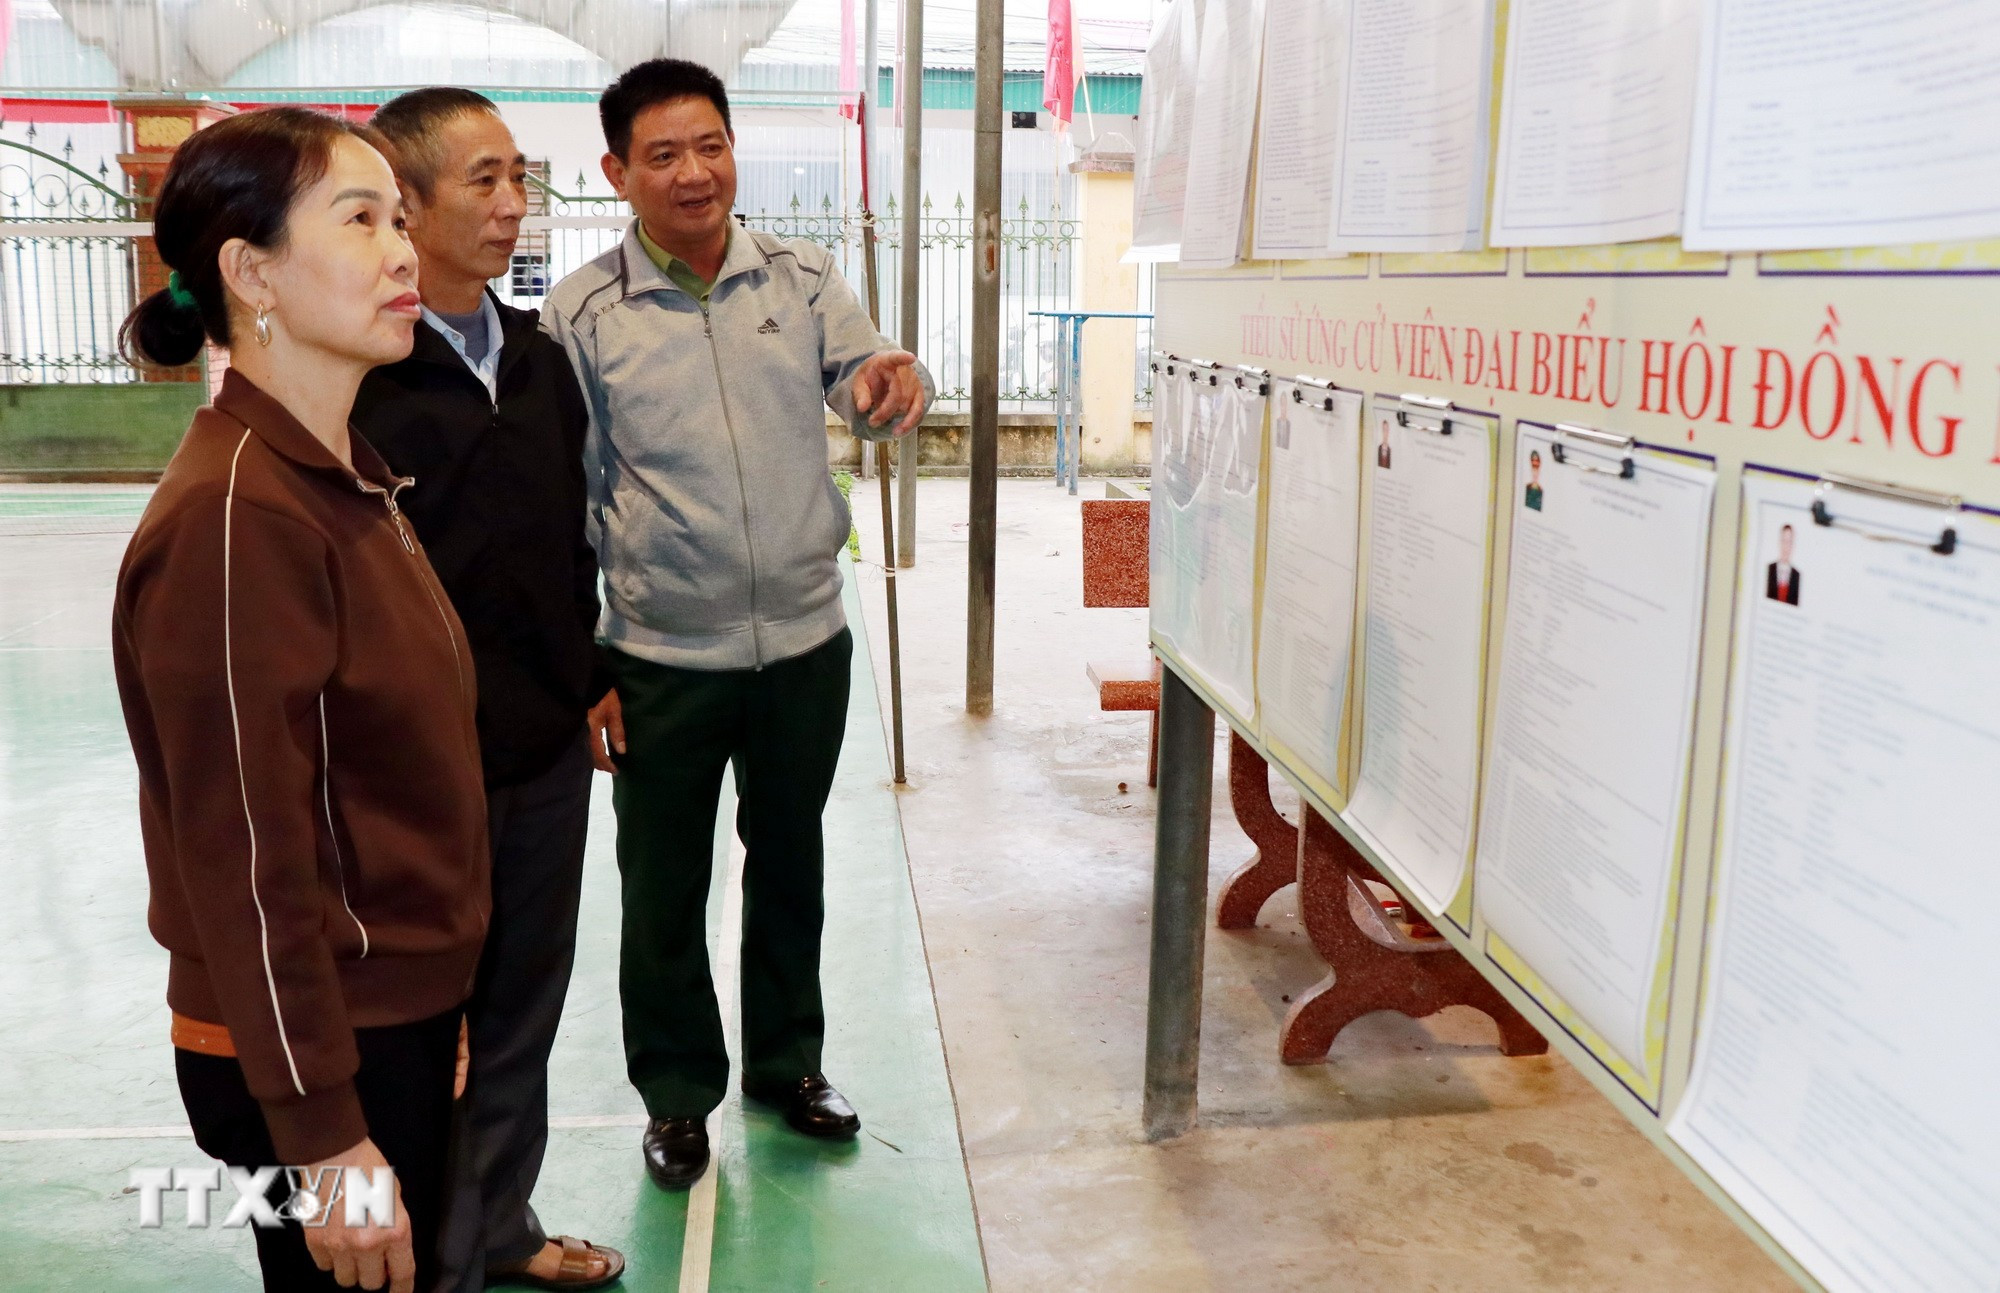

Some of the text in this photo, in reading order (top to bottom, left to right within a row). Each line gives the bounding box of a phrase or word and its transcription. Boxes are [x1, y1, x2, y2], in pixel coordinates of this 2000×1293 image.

[1306, 303, 1347, 368] ỨNG
[1353, 302, 1387, 373] CỬ
[1392, 306, 1458, 382] VIÊN
[1463, 326, 1521, 407] ĐẠI
[1529, 297, 1626, 408] BIỂU
[1637, 316, 1737, 442] HỘI
[1751, 304, 1964, 458] ĐỒNG
